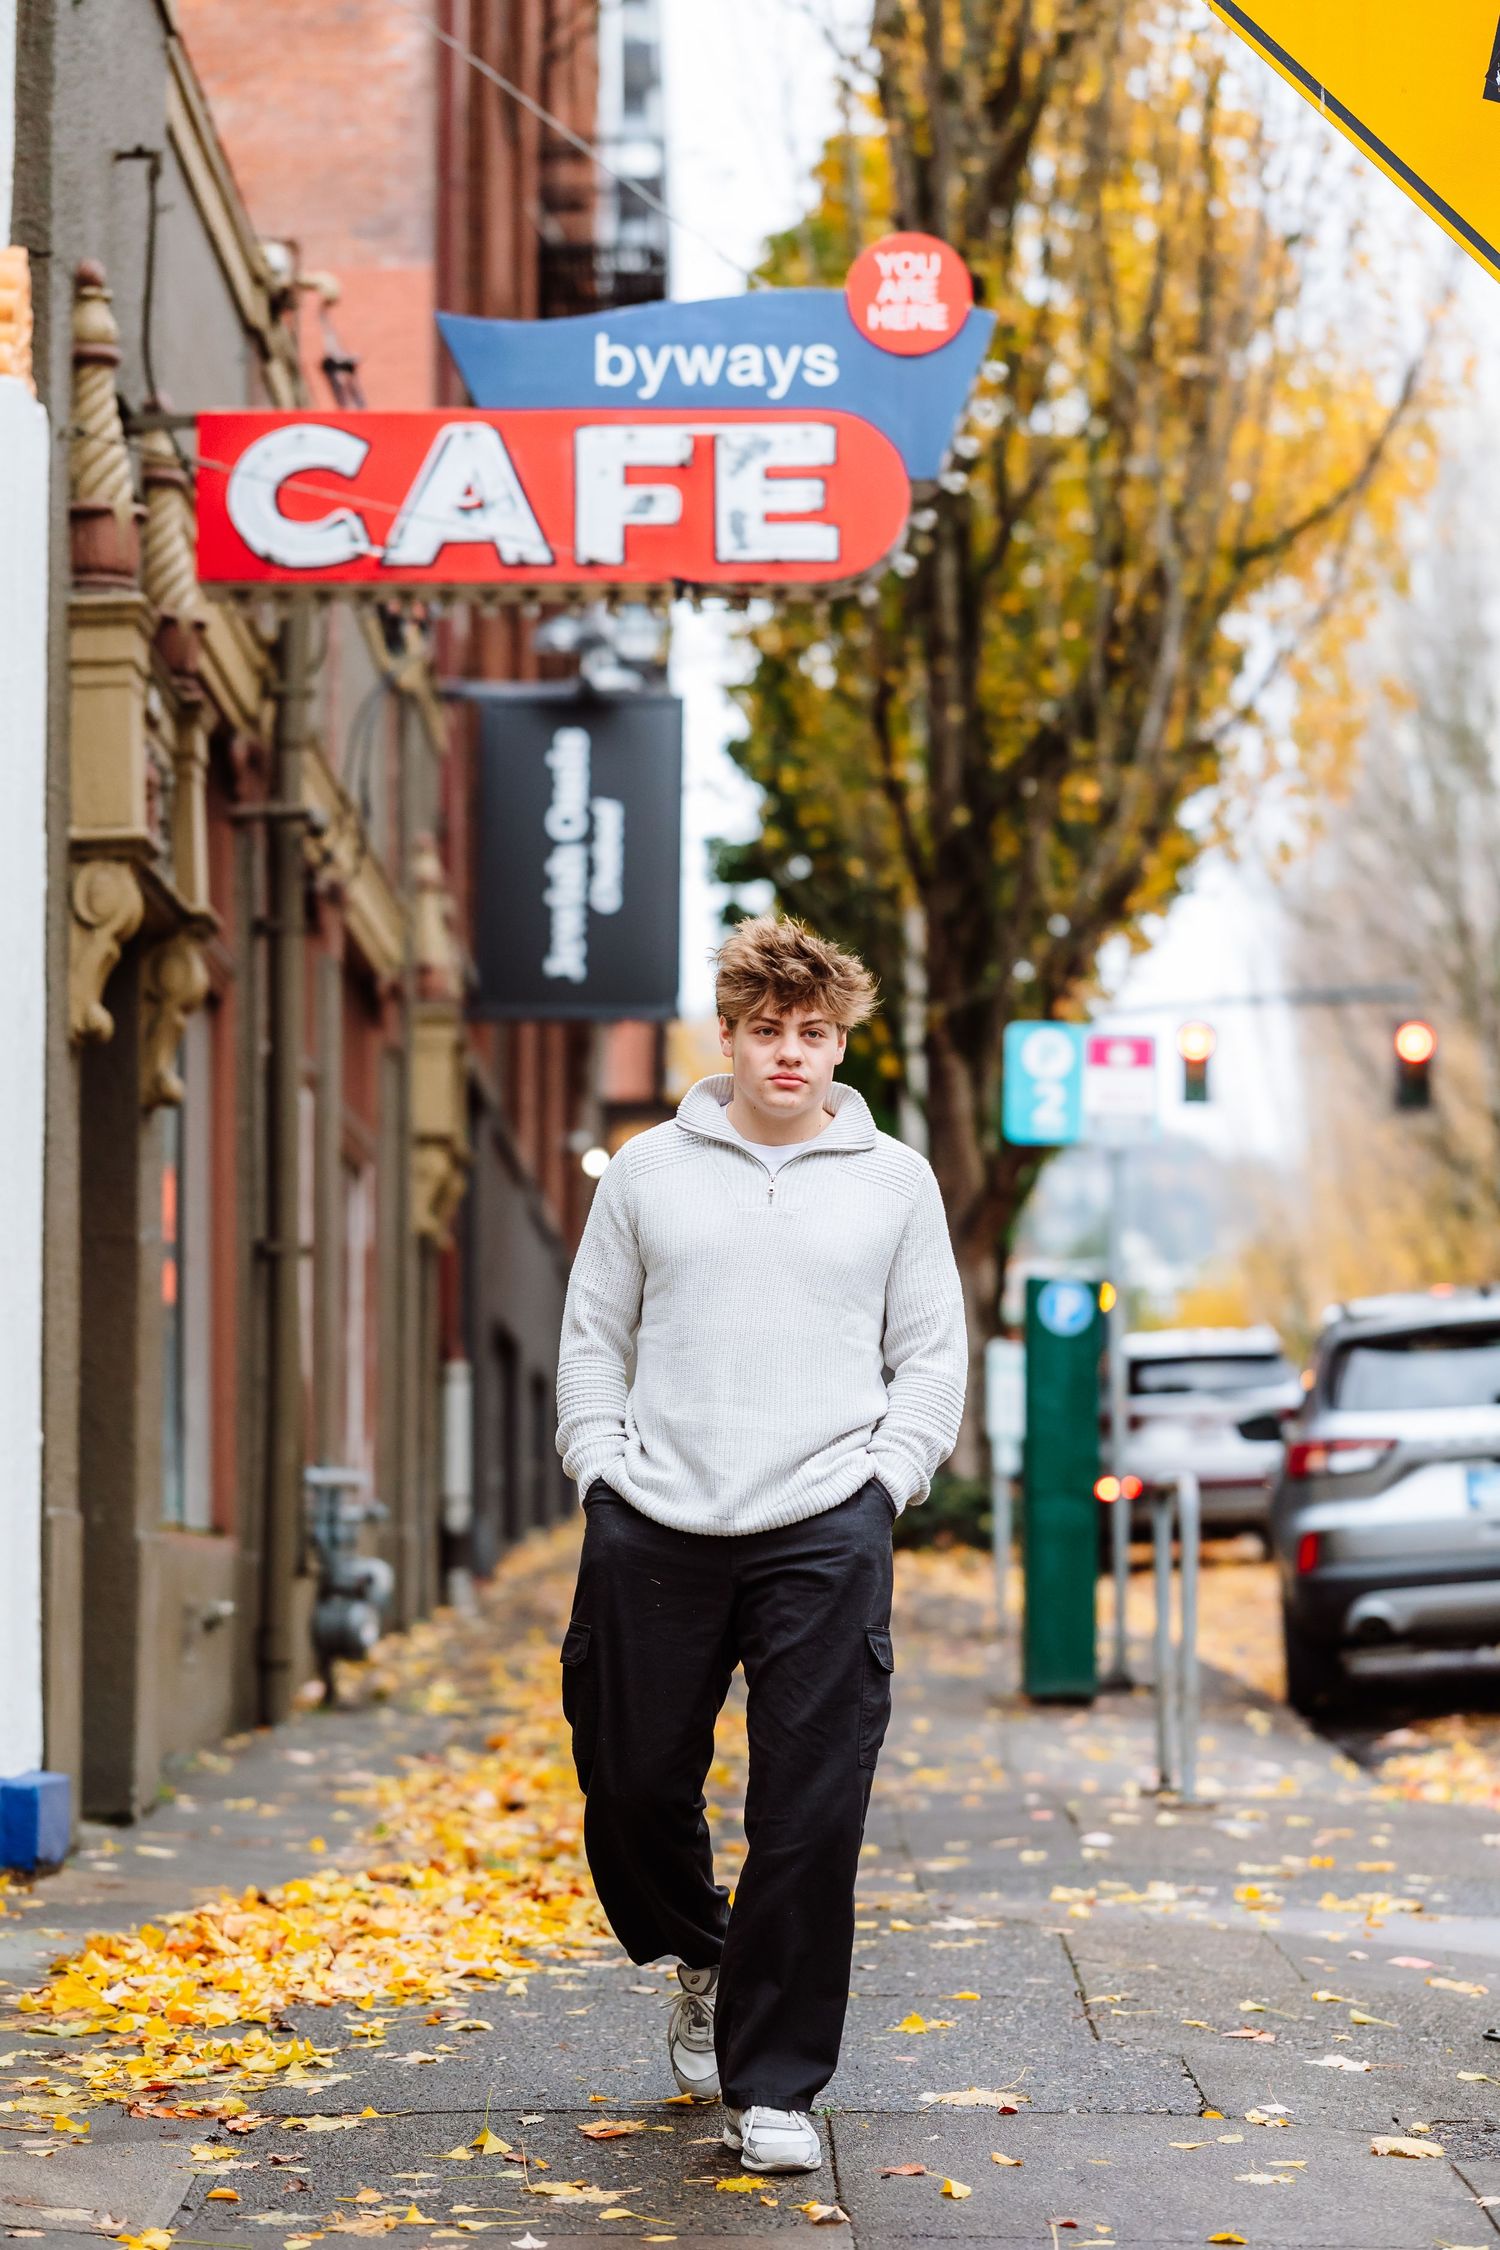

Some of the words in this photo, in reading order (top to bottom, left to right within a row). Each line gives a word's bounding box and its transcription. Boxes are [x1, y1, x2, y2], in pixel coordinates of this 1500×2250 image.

[873, 250, 942, 279] YOU
[875, 278, 939, 304] ARE
[866, 302, 949, 331] HERE
[595, 332, 840, 400] byways
[226, 421, 840, 568] CAFE
